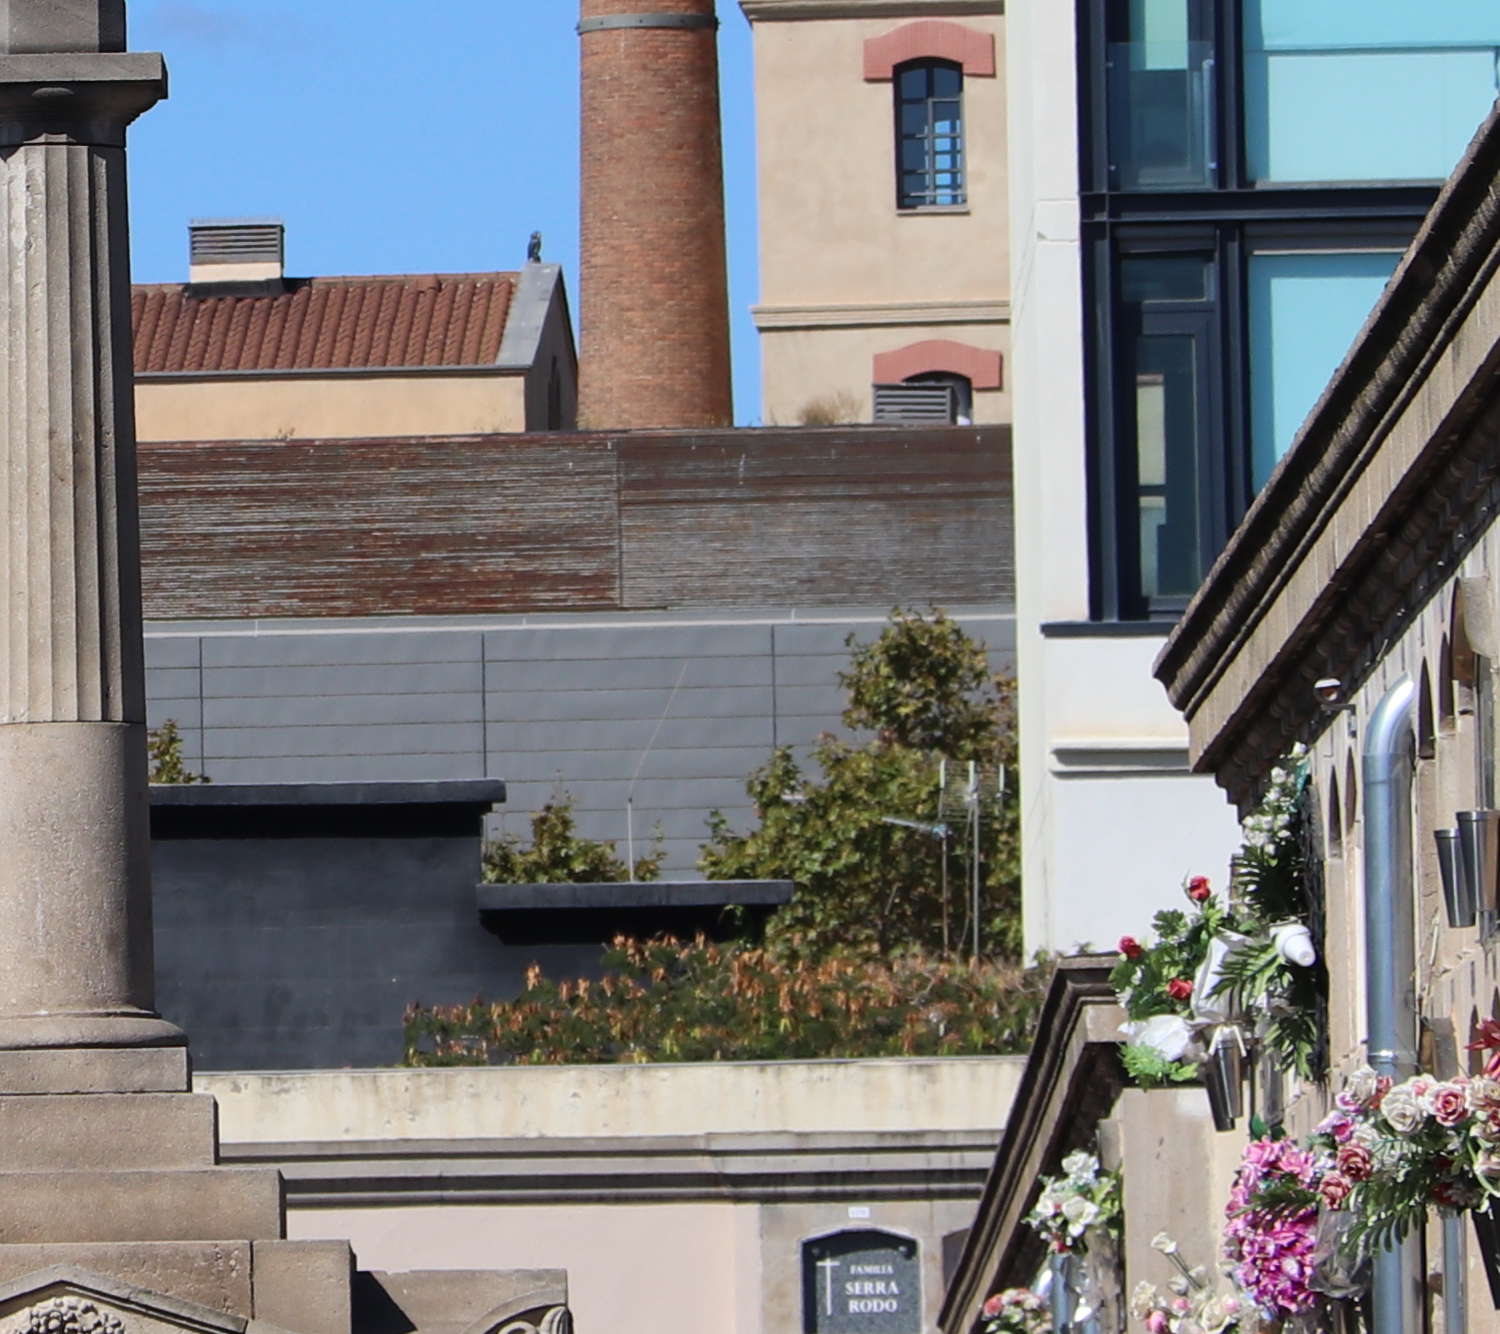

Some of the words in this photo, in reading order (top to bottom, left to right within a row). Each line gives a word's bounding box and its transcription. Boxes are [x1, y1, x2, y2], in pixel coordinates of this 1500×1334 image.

[850, 1264, 894, 1275] FAMILIA
[845, 1281, 899, 1295] SERRA
[848, 1299, 898, 1313] RODO
